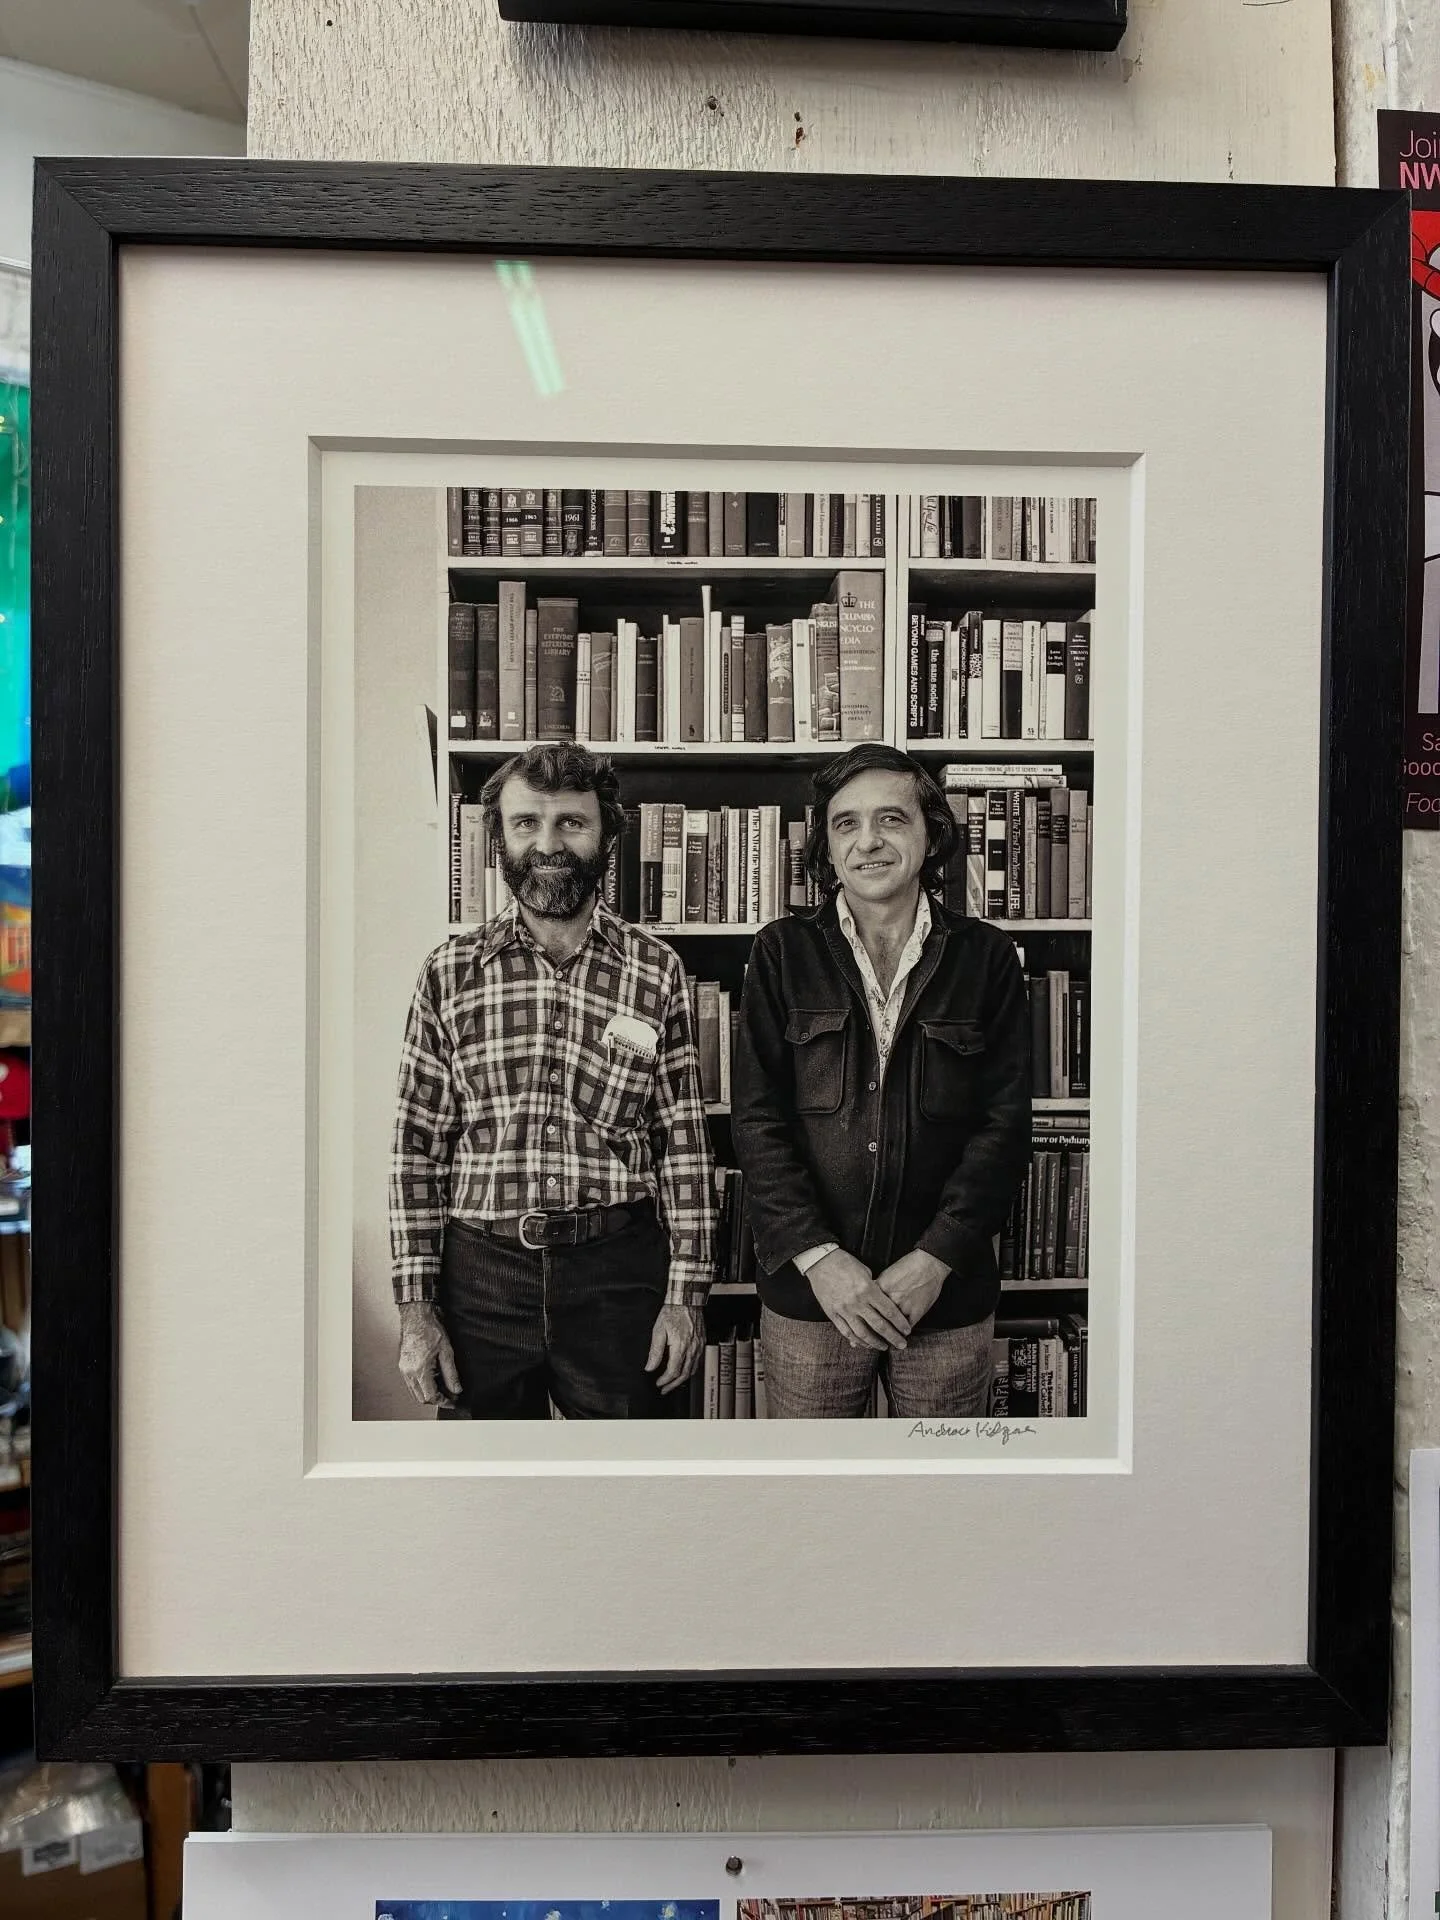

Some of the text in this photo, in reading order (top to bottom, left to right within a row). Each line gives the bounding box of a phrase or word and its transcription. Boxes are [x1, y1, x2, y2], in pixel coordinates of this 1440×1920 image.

[1399, 130, 1440, 158] Joi
[565, 514, 580, 522] 1961
[858, 601, 876, 609] THE
[840, 636, 861, 644] EDIA
[931, 649, 939, 662] the
[929, 684, 939, 712] society
[1012, 817, 1021, 830] The
[452, 839, 462, 900] THOUGHT
[608, 883, 616, 903] MAN
[1010, 888, 1020, 909] LIFE
